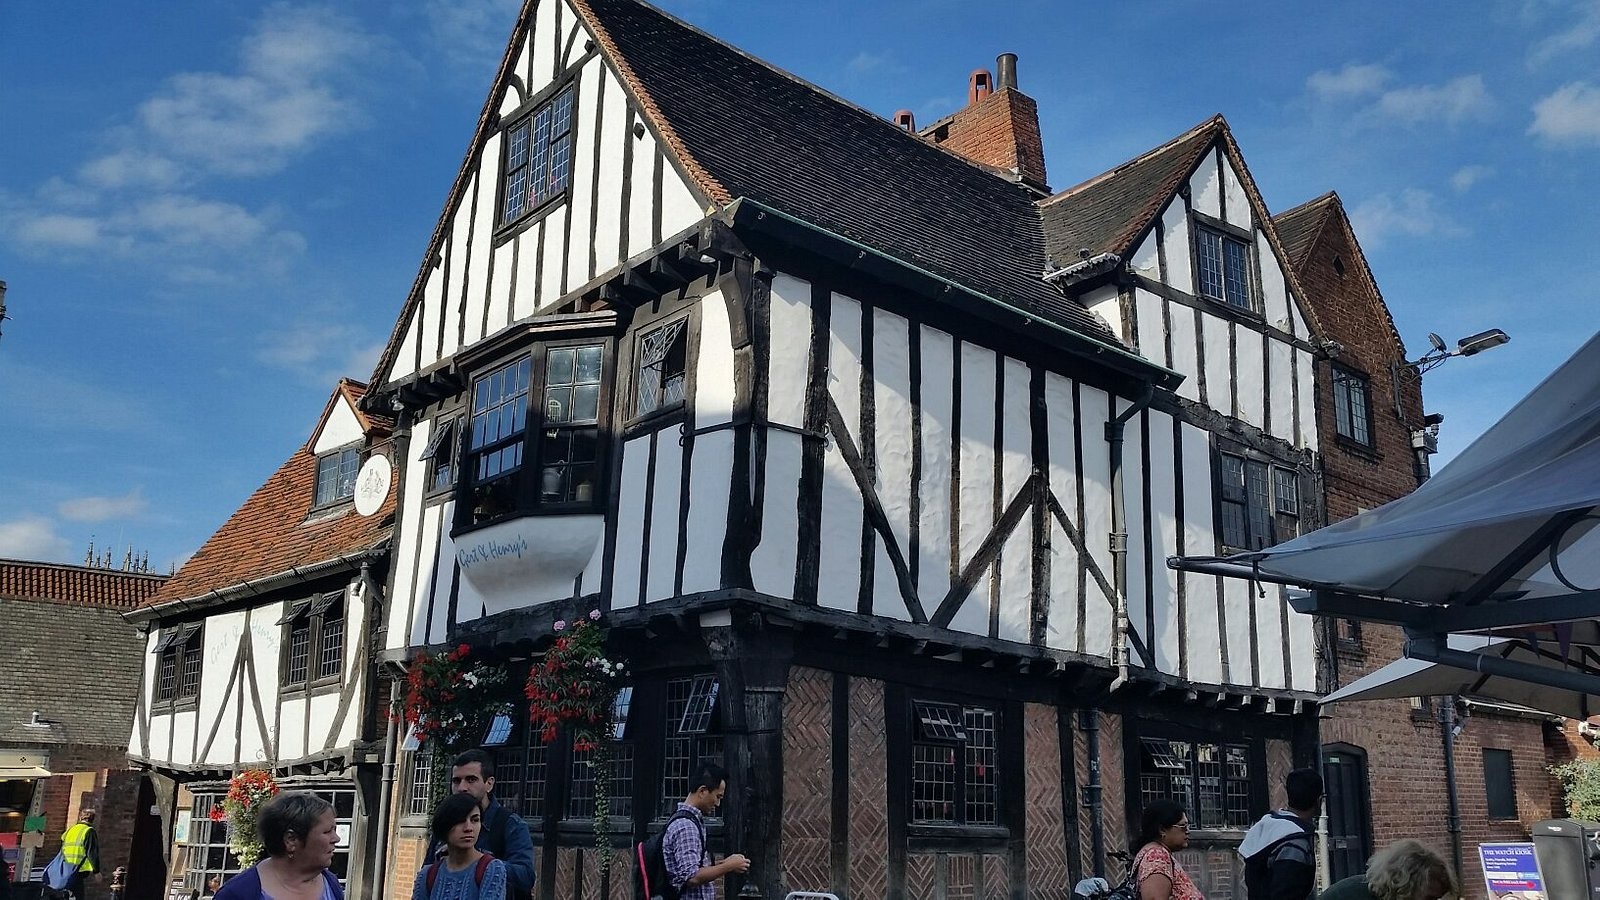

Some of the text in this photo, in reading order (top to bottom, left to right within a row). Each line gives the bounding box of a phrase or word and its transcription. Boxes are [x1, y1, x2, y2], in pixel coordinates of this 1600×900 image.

[459, 533, 528, 568] Gert & Henry's
